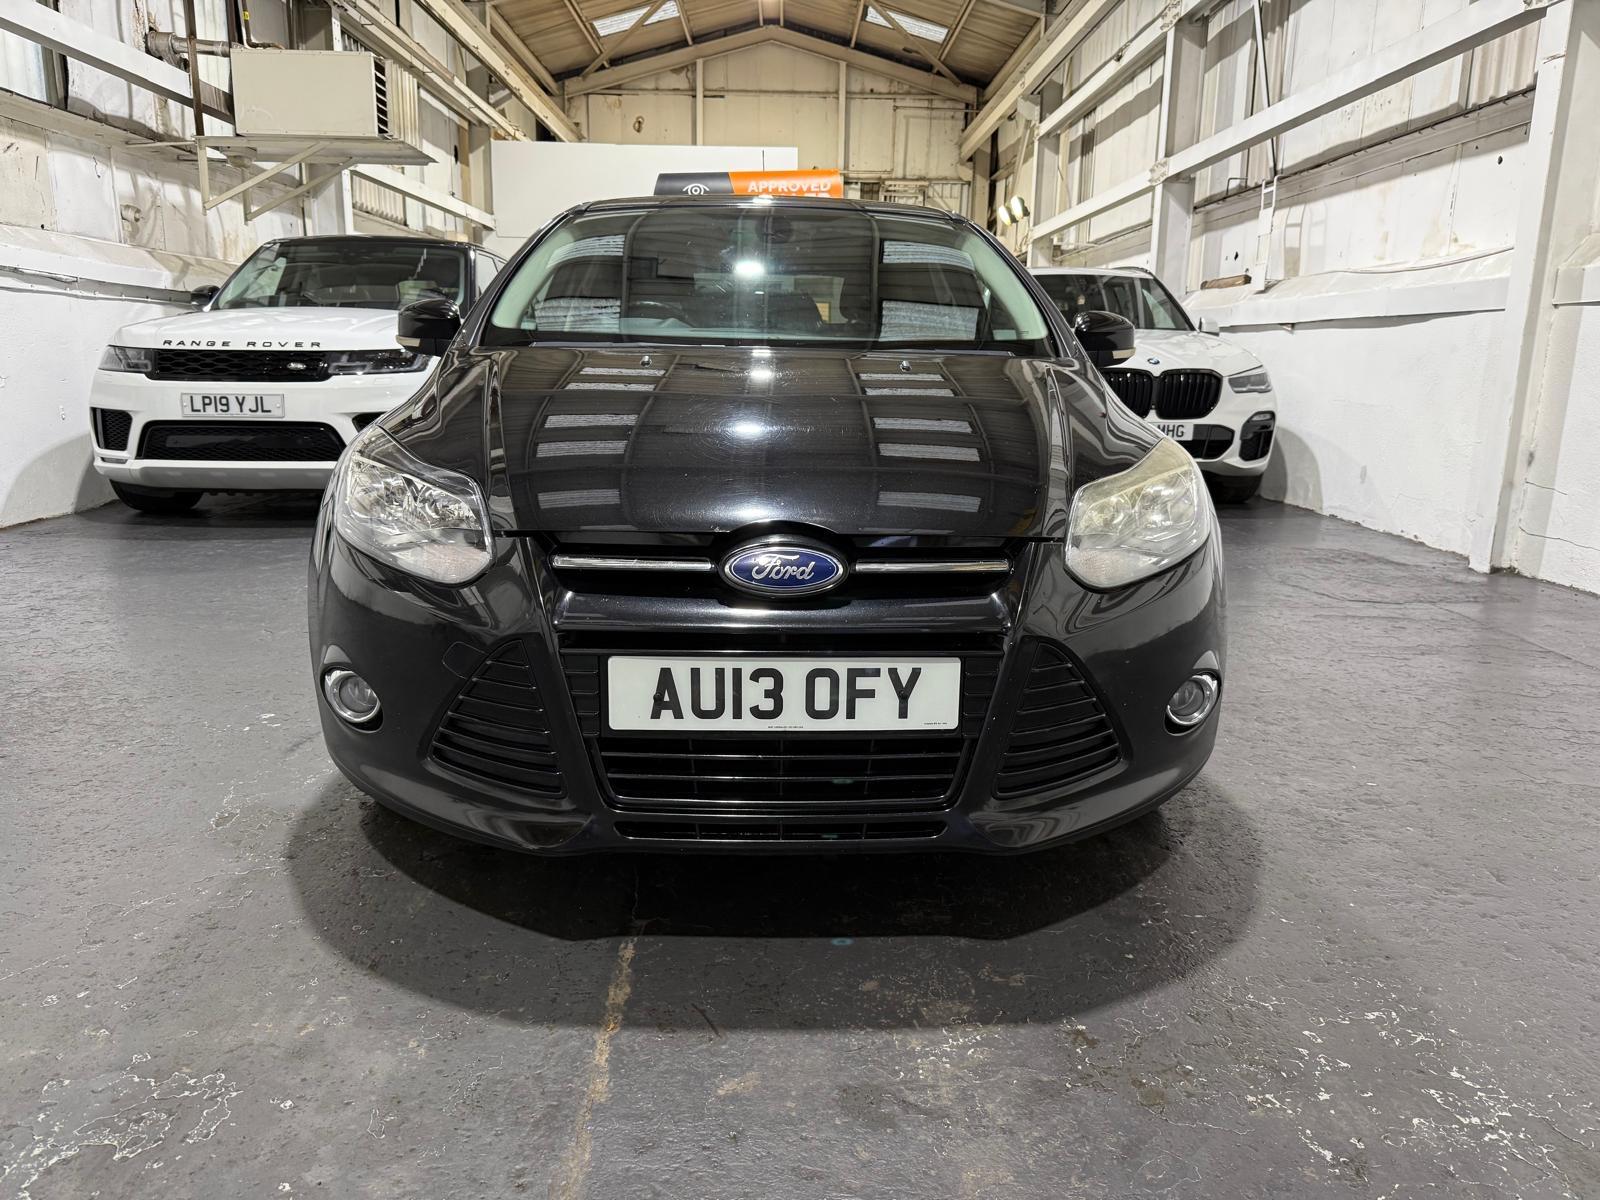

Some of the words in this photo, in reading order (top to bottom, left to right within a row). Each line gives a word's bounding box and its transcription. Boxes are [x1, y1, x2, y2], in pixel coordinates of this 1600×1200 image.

[747, 179, 832, 193] APPROVED
[190, 396, 230, 413] LP19
[235, 396, 272, 413] YJL
[751, 553, 816, 580] Ford
[650, 667, 784, 720] AU13
[805, 667, 922, 720] OFY
